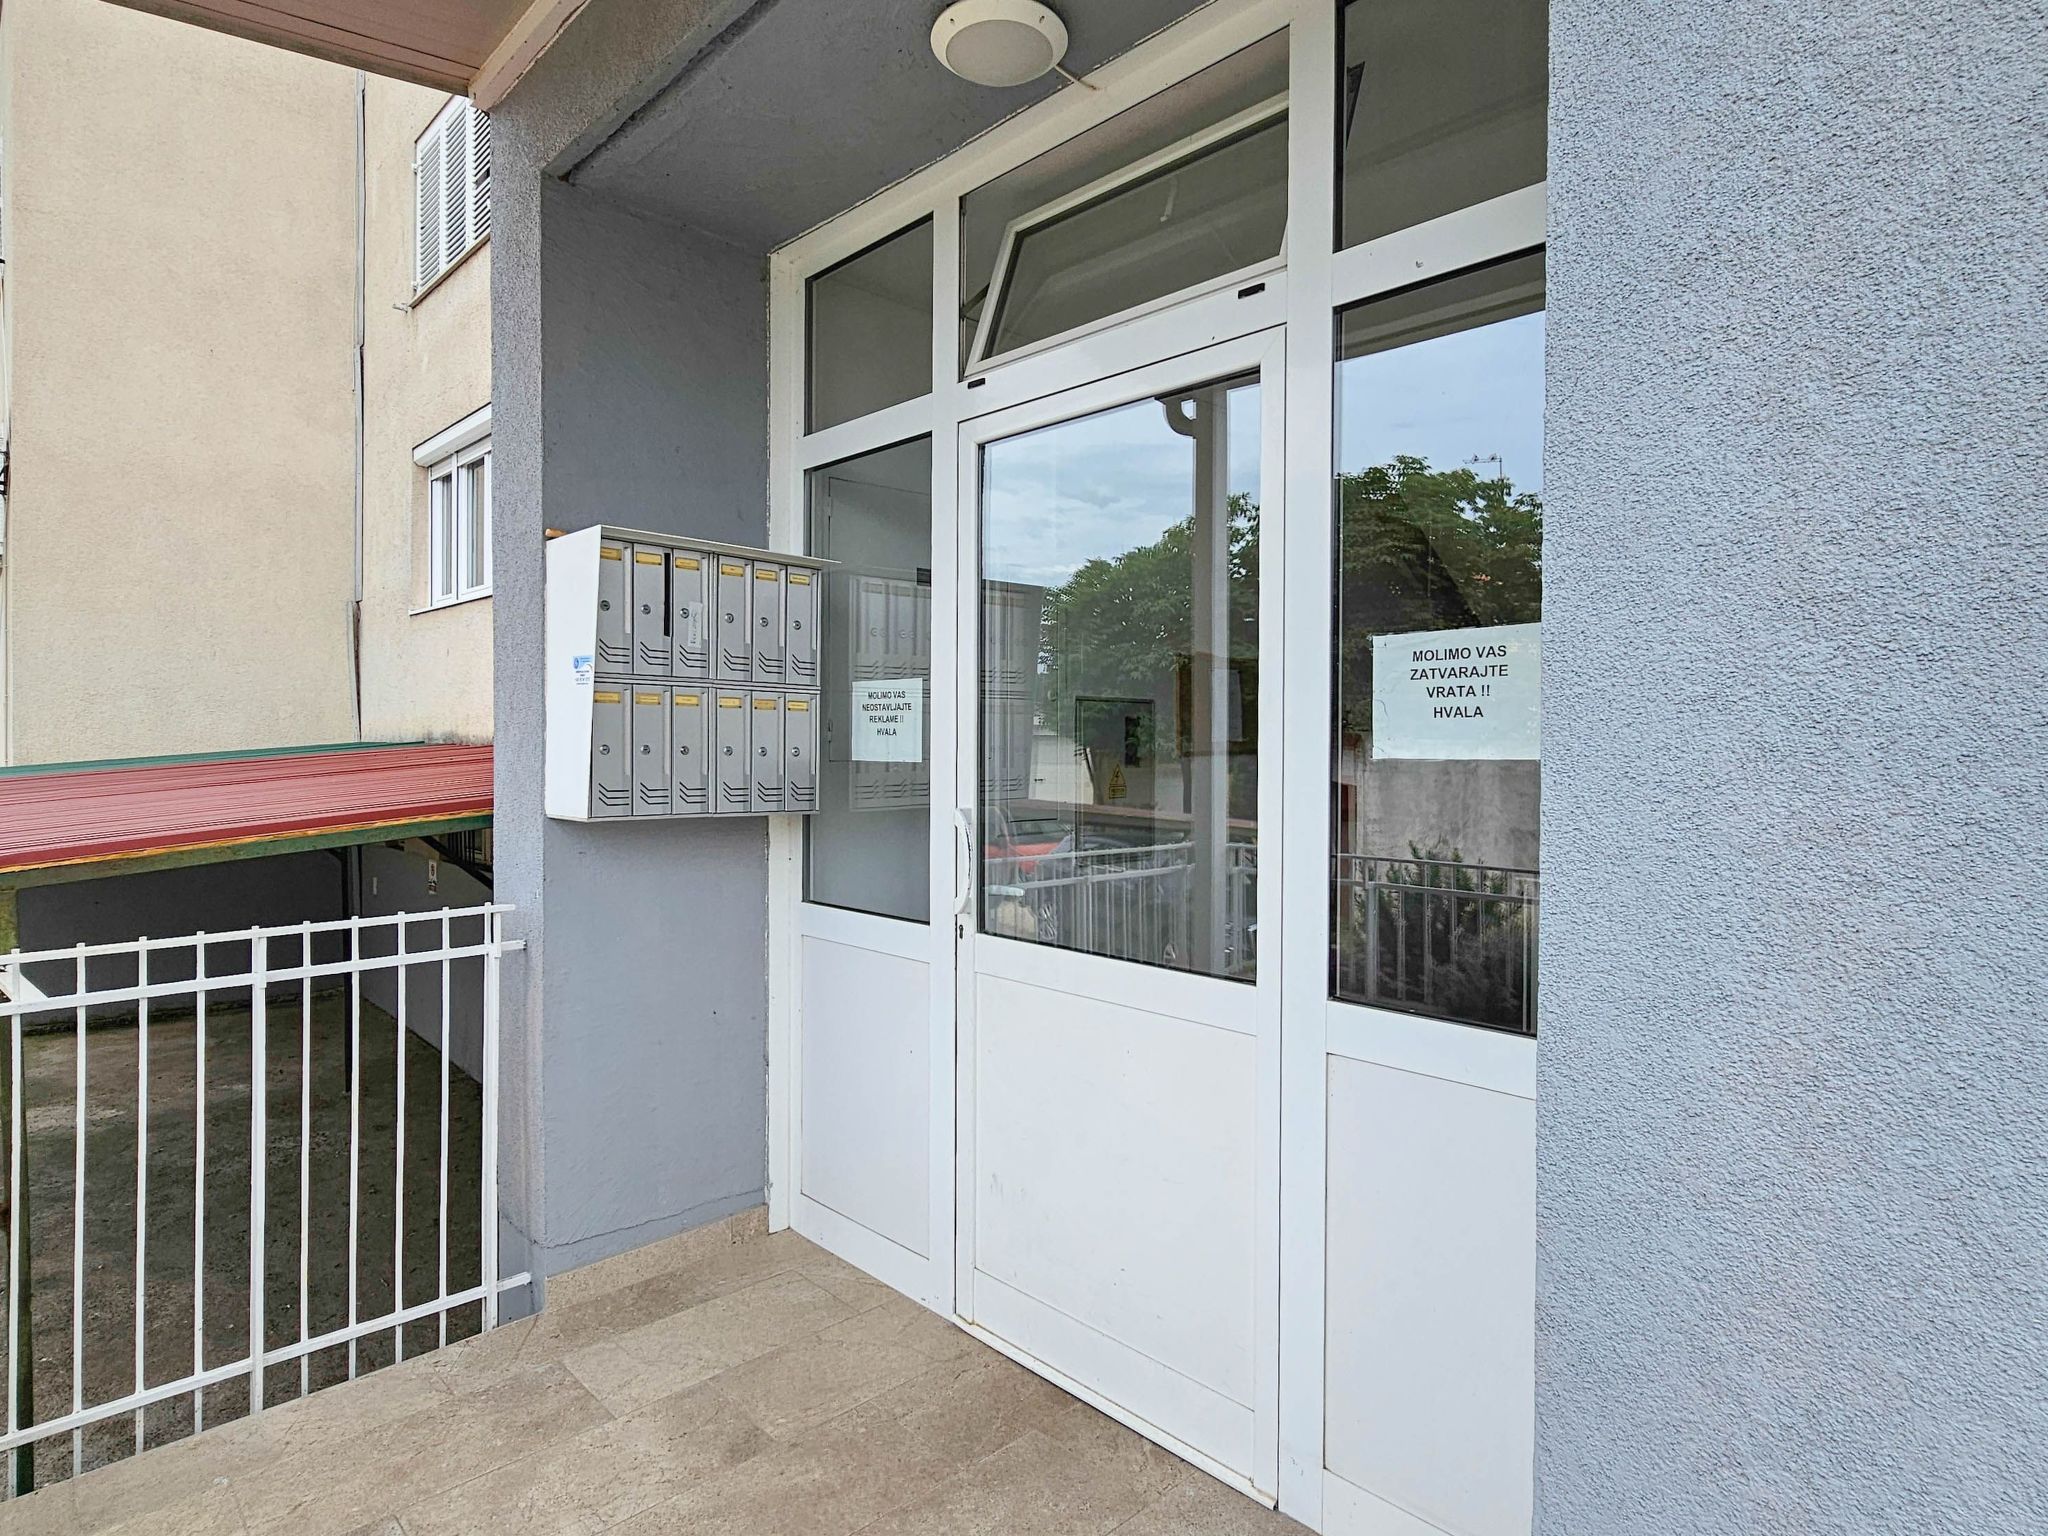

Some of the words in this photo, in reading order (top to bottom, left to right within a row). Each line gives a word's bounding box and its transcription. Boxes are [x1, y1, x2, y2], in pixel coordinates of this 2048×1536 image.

[1412, 647, 1472, 662] MOLIMO
[1475, 645, 1507, 659] VAS
[1410, 664, 1509, 681] ZATVARAJTE
[868, 691, 892, 700] MOLIMO
[893, 690, 906, 699] VAS
[1426, 685, 1477, 699] VRATA
[1481, 684, 1491, 697] !!
[862, 702, 912, 712] NEOSTAVLJAJTE
[1433, 706, 1484, 719] HVALA
[869, 715, 899, 723] REKLAME
[877, 728, 897, 736] HVALA
